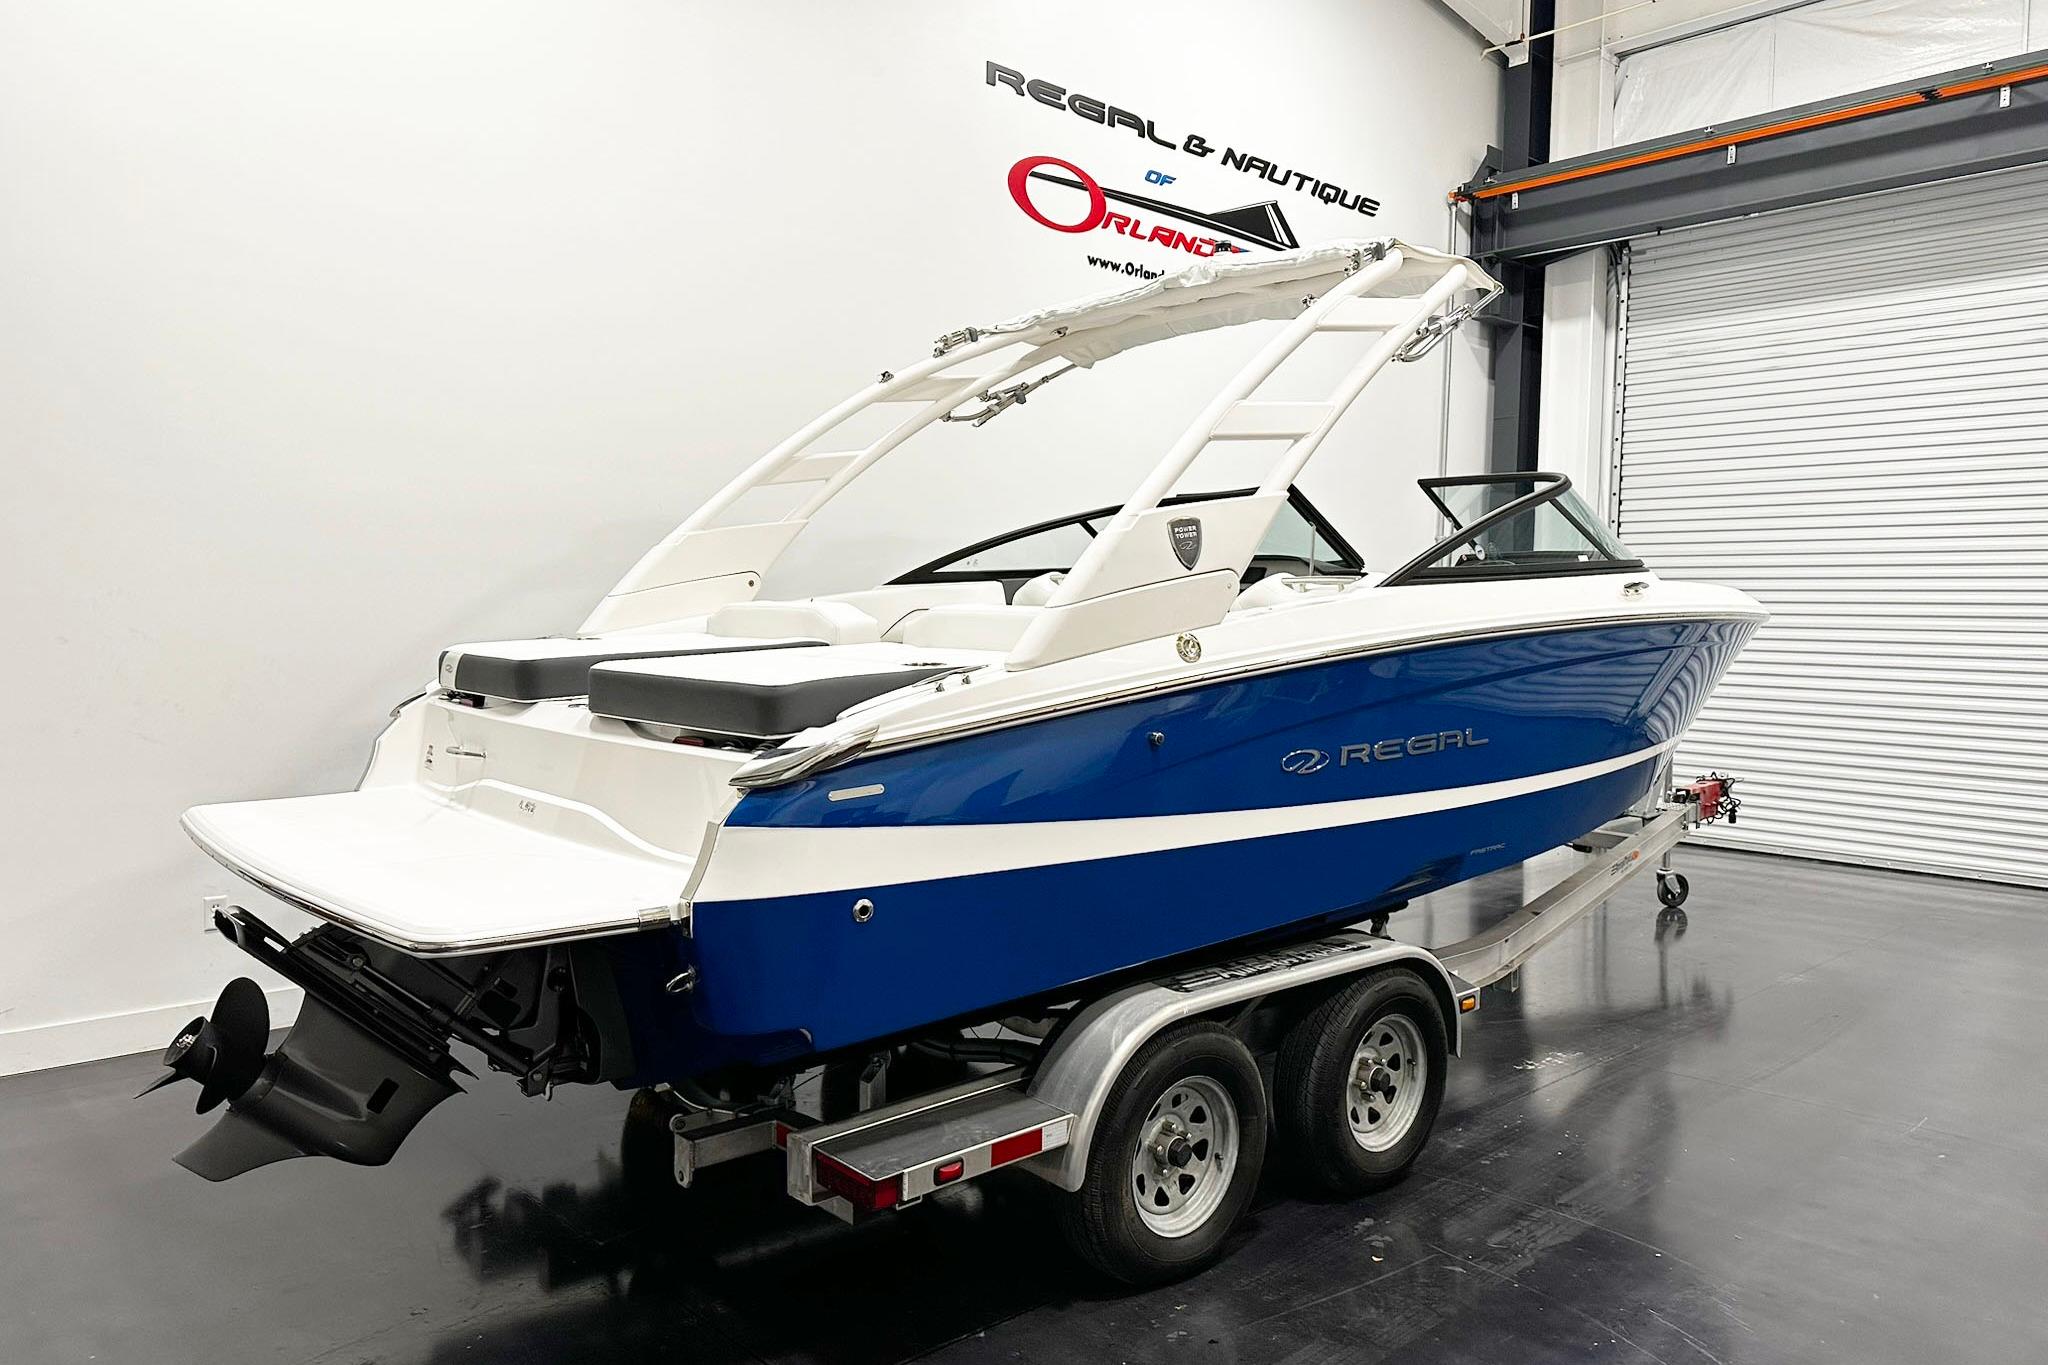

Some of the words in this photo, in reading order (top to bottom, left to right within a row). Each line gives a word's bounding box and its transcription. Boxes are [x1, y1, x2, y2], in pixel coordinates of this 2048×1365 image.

[986, 60, 1176, 150] REGAL
[1183, 134, 1215, 157] &
[1221, 147, 1381, 217] NAUTIQUE
[1144, 169, 1176, 186] OF
[1007, 155, 1241, 257] ORLAND
[1087, 255, 1165, 279] www.Orlan
[1174, 525, 1197, 533] POWER
[1175, 531, 1197, 539] TOWER
[1340, 728, 1489, 766] REGAL
